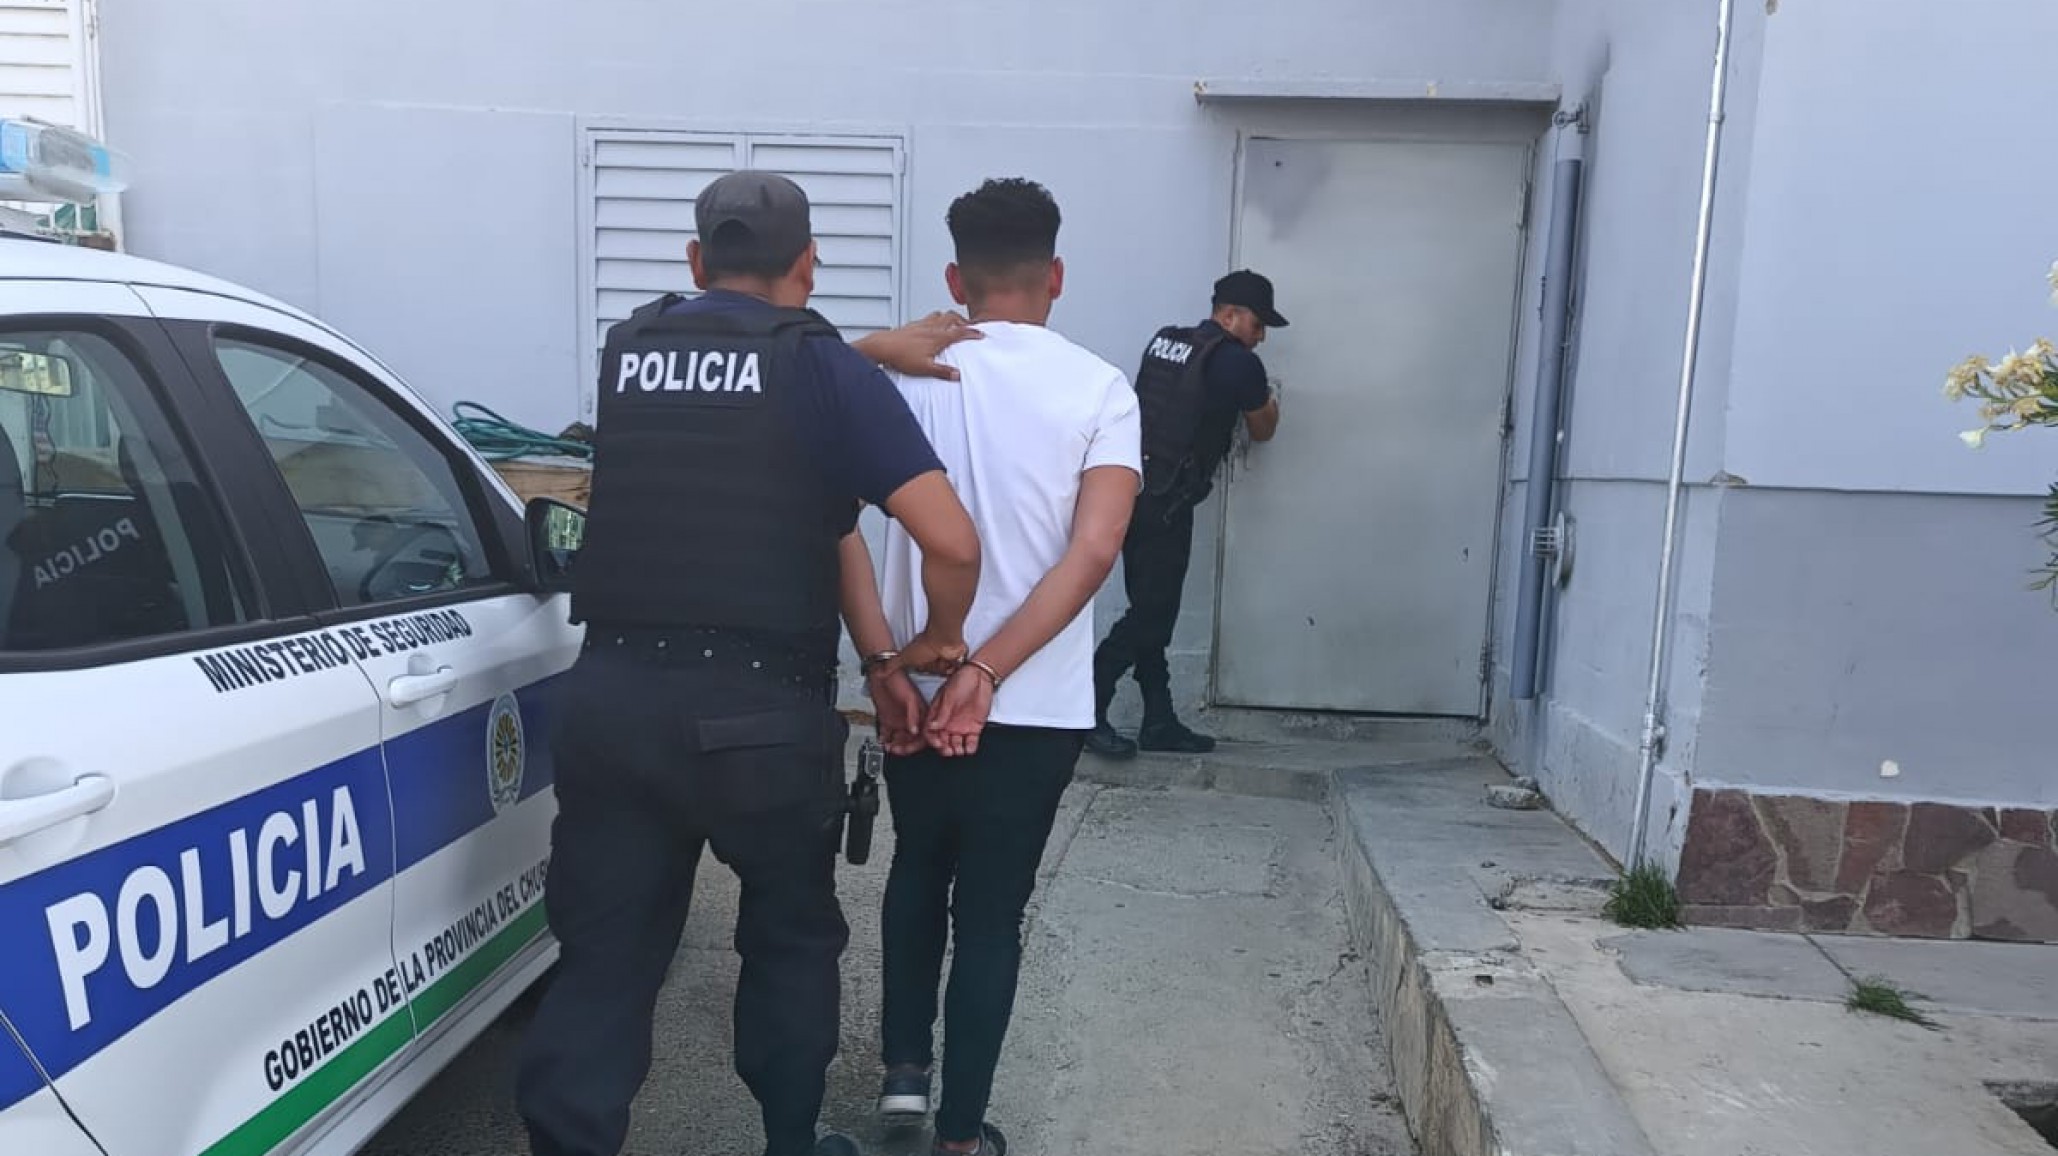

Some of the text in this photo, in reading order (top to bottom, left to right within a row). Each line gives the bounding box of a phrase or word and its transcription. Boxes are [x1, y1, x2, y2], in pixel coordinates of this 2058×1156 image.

[616, 351, 762, 393] POLICIA
[193, 608, 472, 693] MINISTERIO DE SEGURIDAD
[45, 785, 365, 1032] POLICIA
[264, 988, 373, 1092] GOBIERNO
[373, 968, 401, 1015] DE
[401, 951, 426, 993] LA
[424, 897, 498, 967] PROVINCIA
[497, 880, 520, 922] DEL
